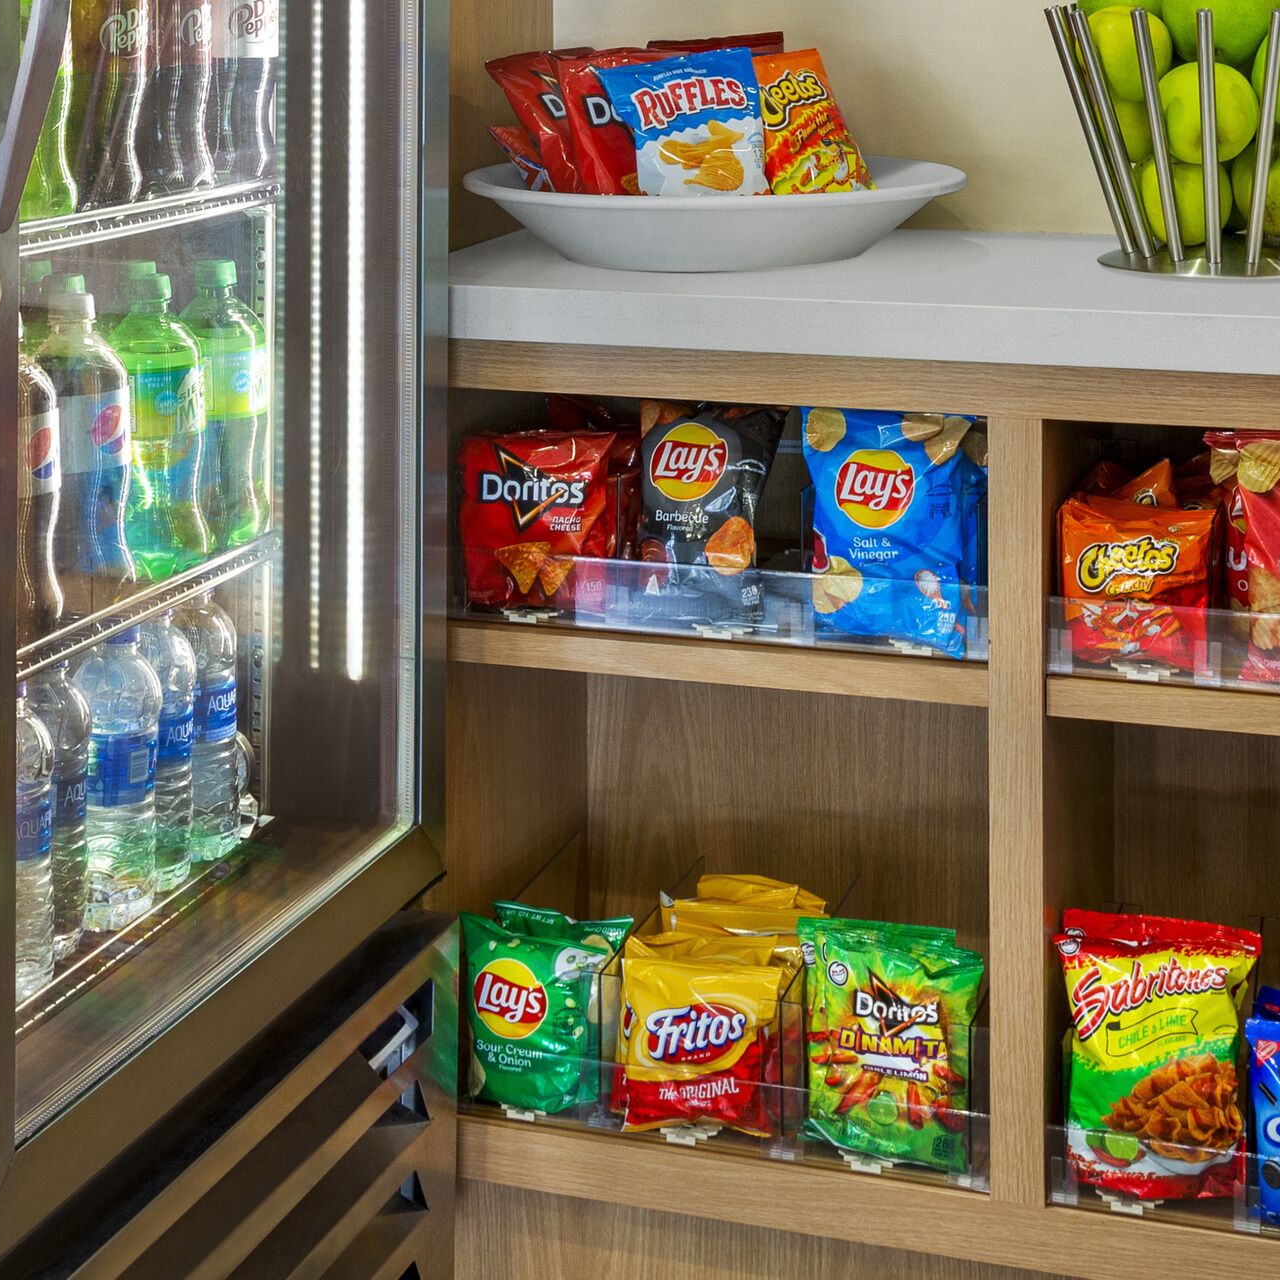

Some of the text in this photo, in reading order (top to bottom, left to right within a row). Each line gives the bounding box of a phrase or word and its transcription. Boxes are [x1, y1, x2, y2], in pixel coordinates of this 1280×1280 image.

[633, 77, 746, 130] RUFFLES
[653, 441, 725, 479] Lay's
[483, 473, 585, 504] Doritos
[837, 463, 914, 510] Lay's
[656, 509, 709, 526] Barbecue
[1079, 538, 1177, 590] Cheetos
[477, 978, 543, 1021] Lay's
[856, 992, 939, 1023] Doritos
[1072, 957, 1228, 1039] Sabritones
[646, 1006, 746, 1060] Fritos
